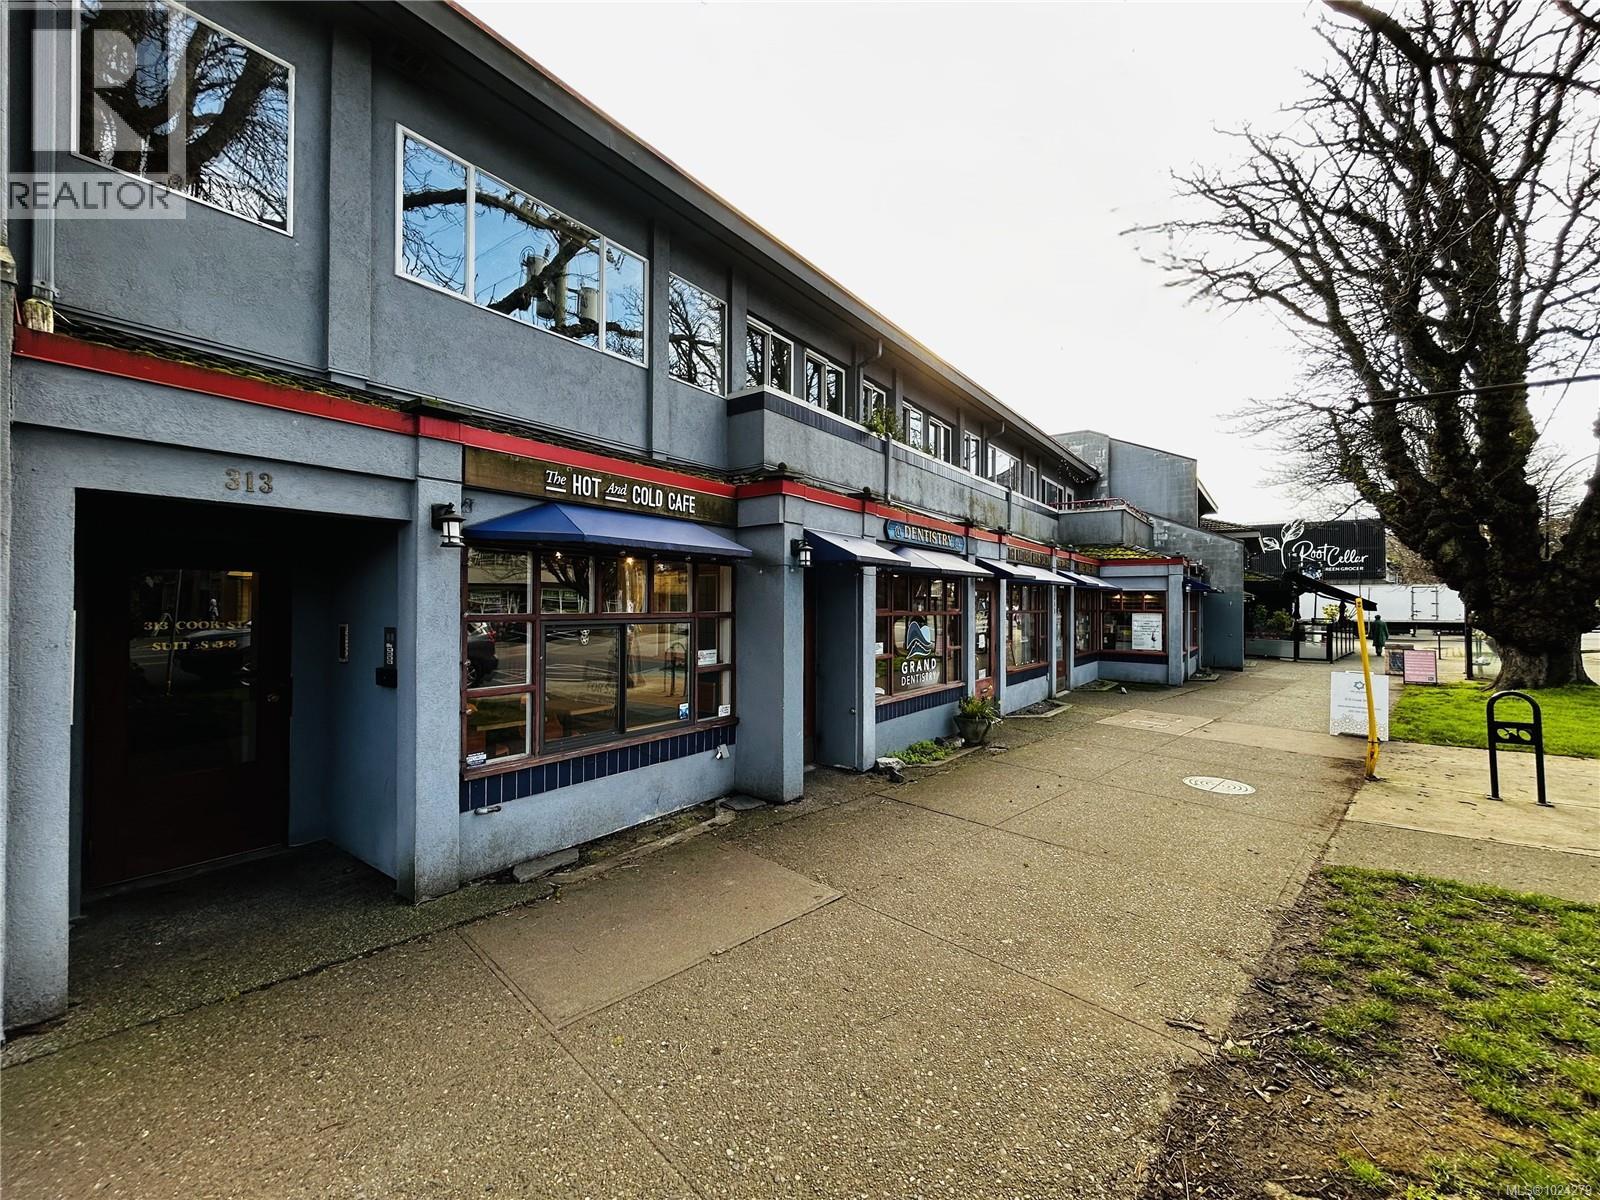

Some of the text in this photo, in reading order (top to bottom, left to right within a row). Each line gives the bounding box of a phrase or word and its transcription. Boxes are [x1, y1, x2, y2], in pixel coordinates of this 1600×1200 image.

[225, 468, 273, 494] 313
[546, 470, 696, 514] The HOT And COLD CAFE
[904, 525, 955, 547] DENTISTRY
[1292, 540, 1369, 567] Root Cellar
[143, 621, 169, 631] 313
[901, 657, 937, 675] GRAND
[901, 671, 938, 687] DENTISTRY
